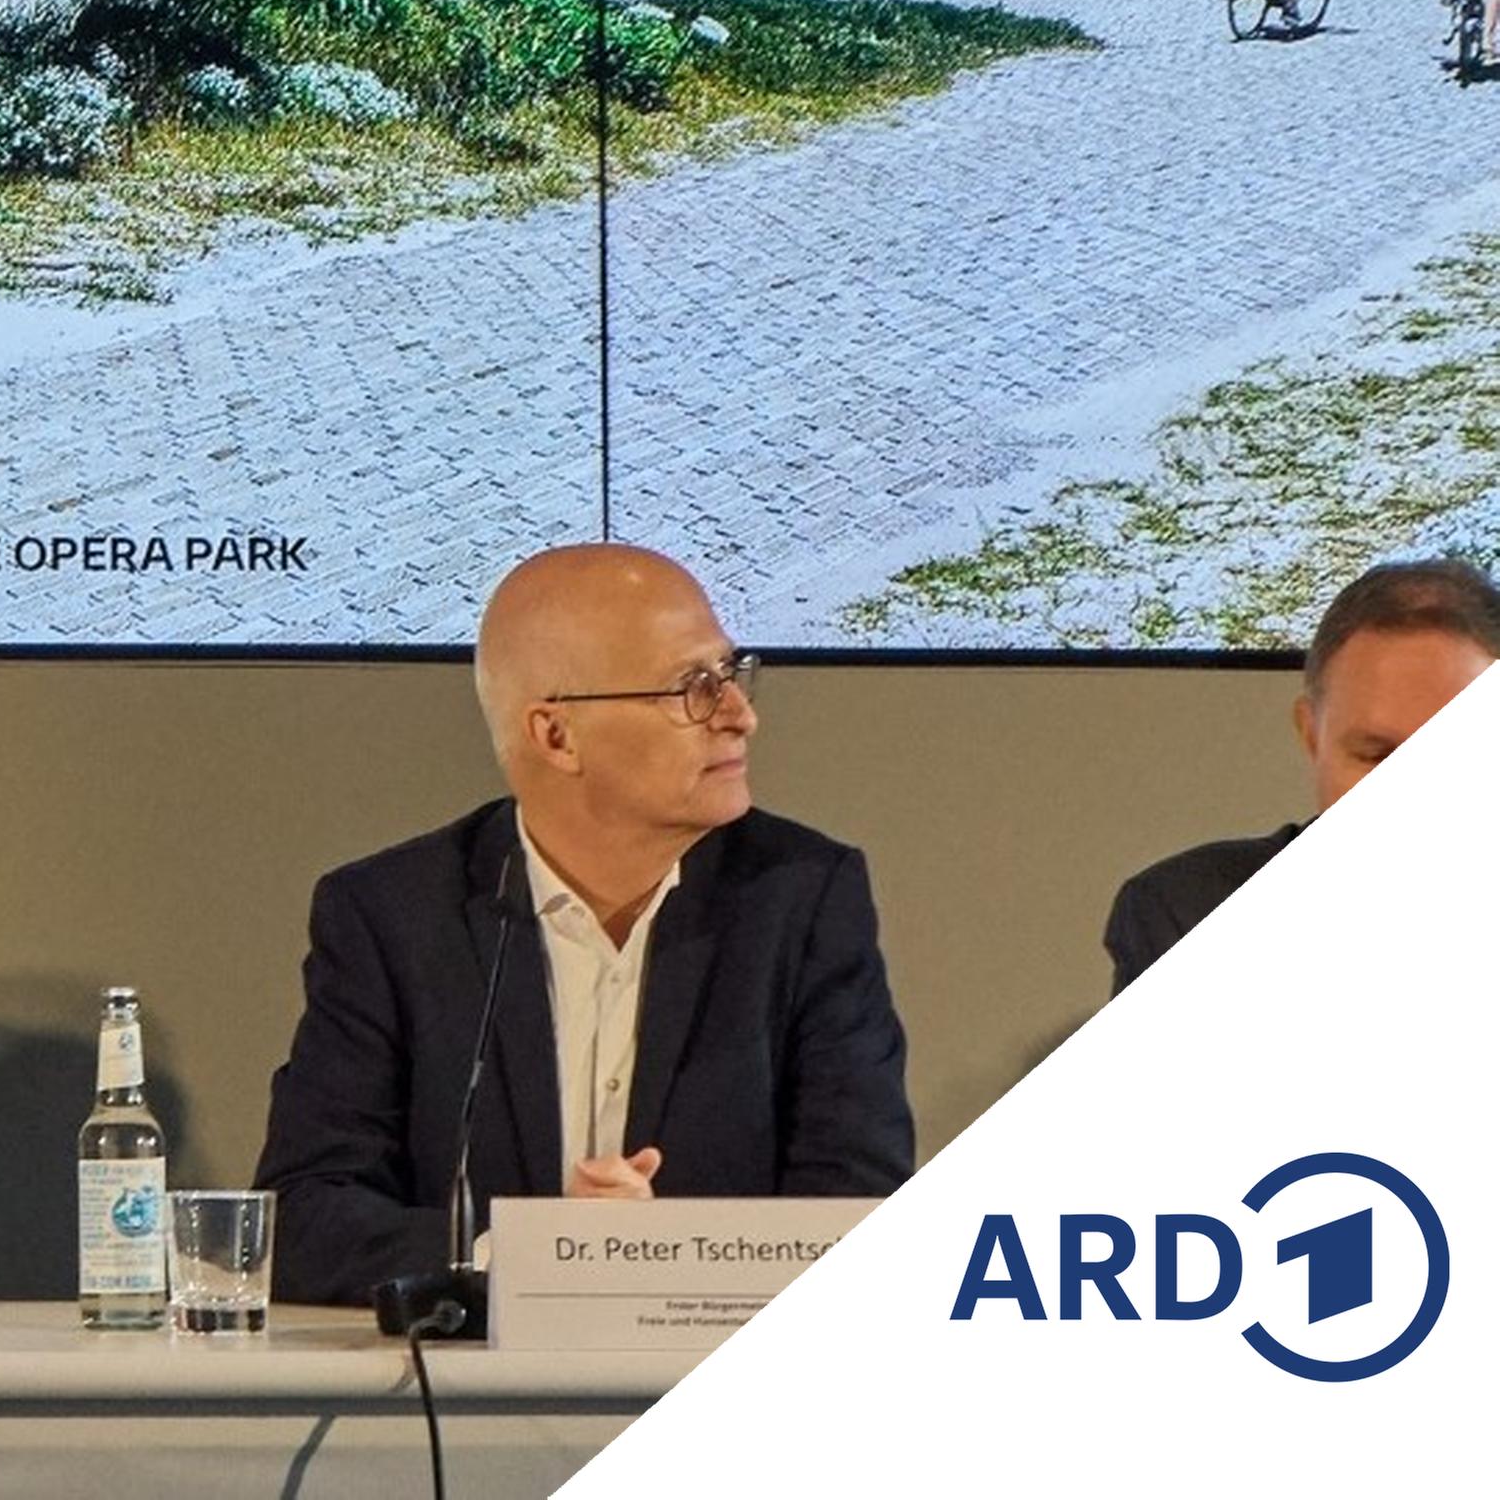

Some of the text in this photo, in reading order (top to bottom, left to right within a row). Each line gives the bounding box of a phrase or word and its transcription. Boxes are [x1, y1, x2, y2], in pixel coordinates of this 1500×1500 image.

[14, 536, 175, 572] OPERA
[185, 536, 308, 571] PARK
[555, 1236, 842, 1262] Dr. Peter Tschentsc
